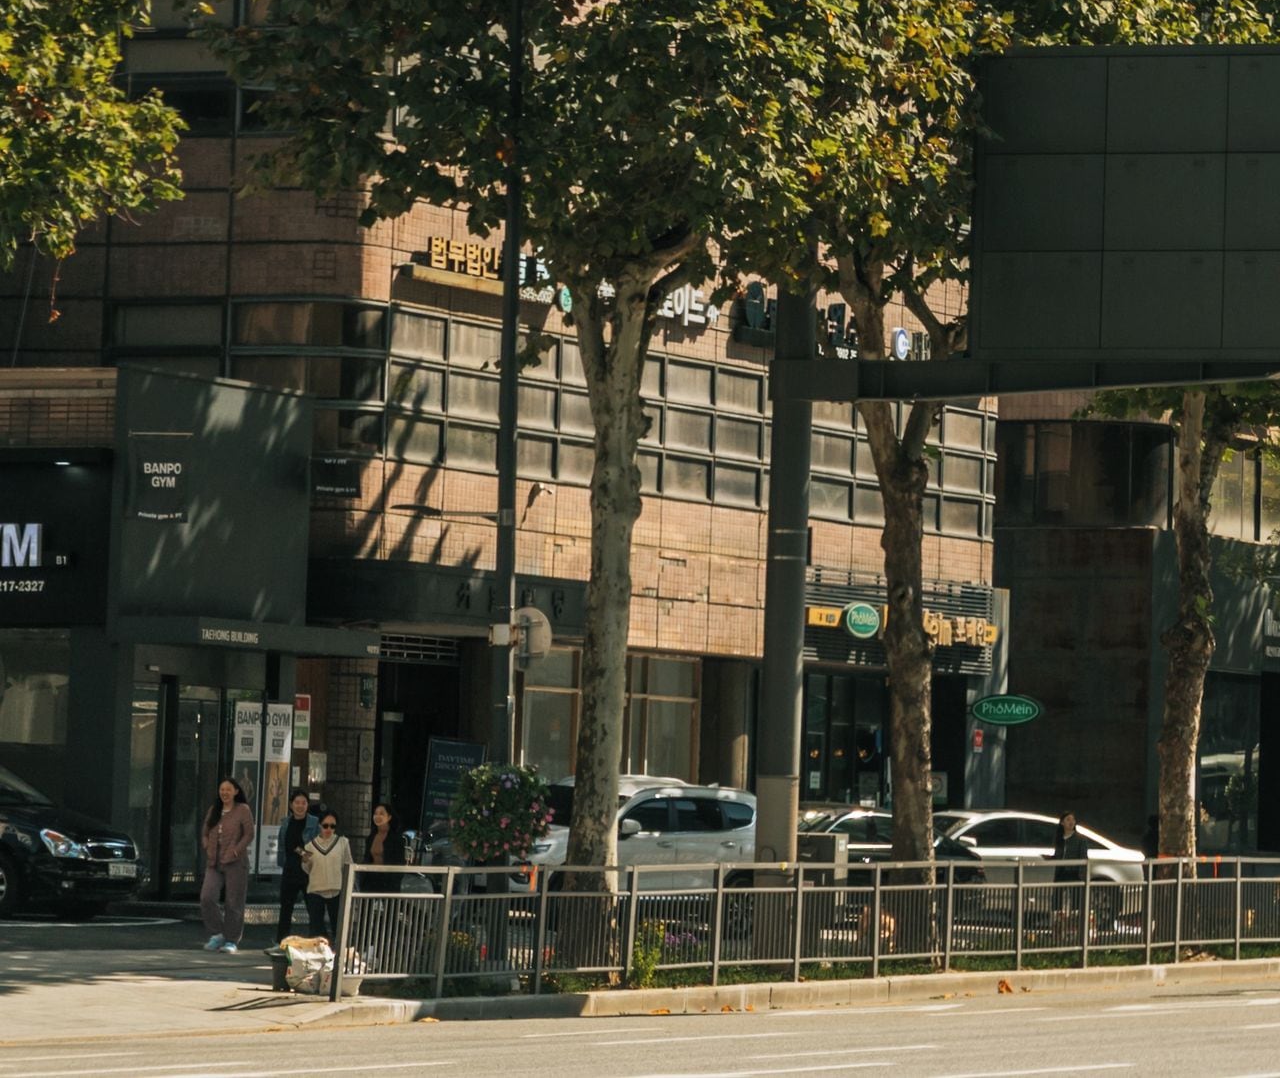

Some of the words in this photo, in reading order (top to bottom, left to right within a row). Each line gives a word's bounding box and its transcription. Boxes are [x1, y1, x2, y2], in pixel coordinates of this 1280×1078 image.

[431, 235, 499, 280] 법무법인
[143, 462, 182, 475] BANPO
[151, 476, 176, 488] GYM
[56, 555, 67, 565] B1
[201, 628, 230, 642] TAEHONG
[231, 631, 259, 644] BUILDING
